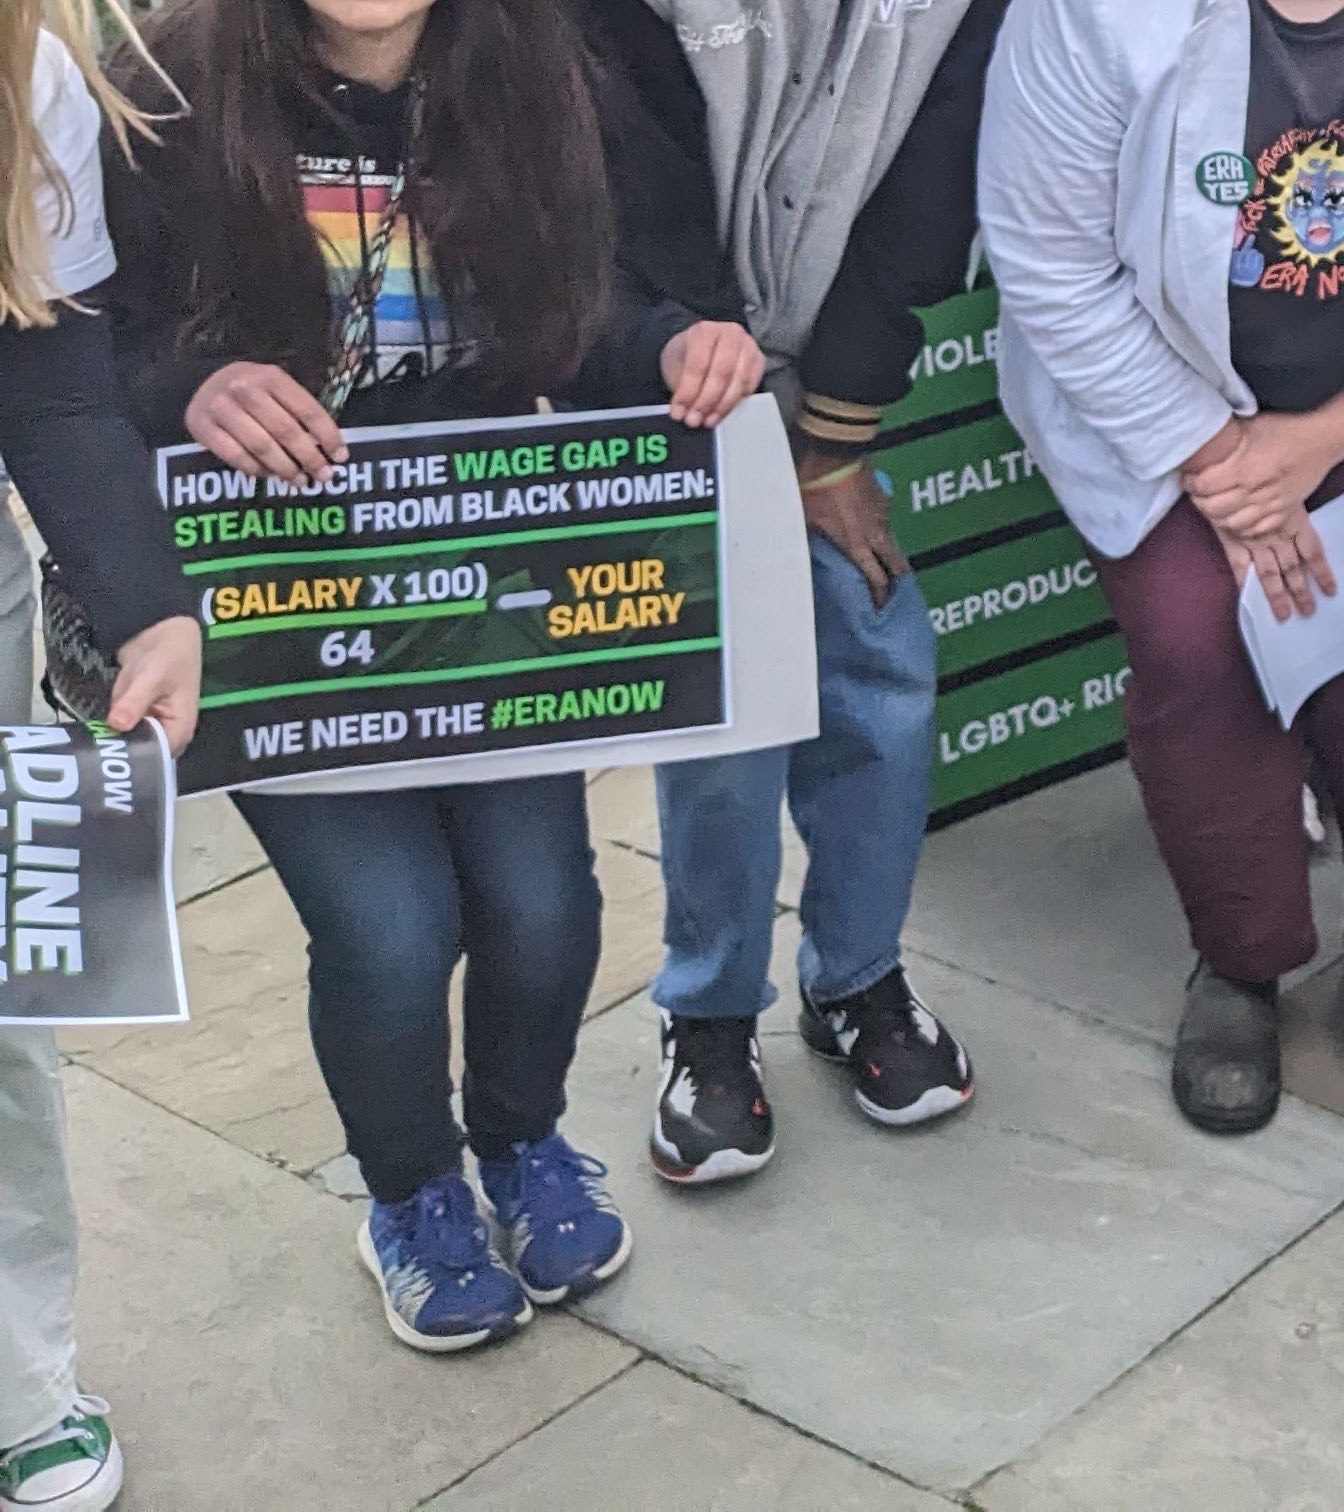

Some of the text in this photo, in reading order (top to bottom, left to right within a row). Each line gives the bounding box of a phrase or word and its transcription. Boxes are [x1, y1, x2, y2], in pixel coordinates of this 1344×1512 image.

[1203, 154, 1244, 180] ERA
[1204, 180, 1249, 201] YES
[1260, 260, 1309, 296] ERA
[173, 470, 257, 506] HOW
[380, 454, 449, 489] THE
[453, 443, 557, 483] WAGE
[562, 438, 628, 473] GAP
[635, 434, 668, 465] IS
[174, 468, 716, 549] STEALING FROM BLACK WOMEN:
[201, 562, 488, 627] (SALARY X 100)
[567, 558, 664, 598] YOUR
[548, 591, 686, 639] SALARY
[320, 628, 375, 667] 64
[244, 680, 665, 761] WE NEED THE #ERANOW
[940, 694, 1074, 765] LGBTQ+
